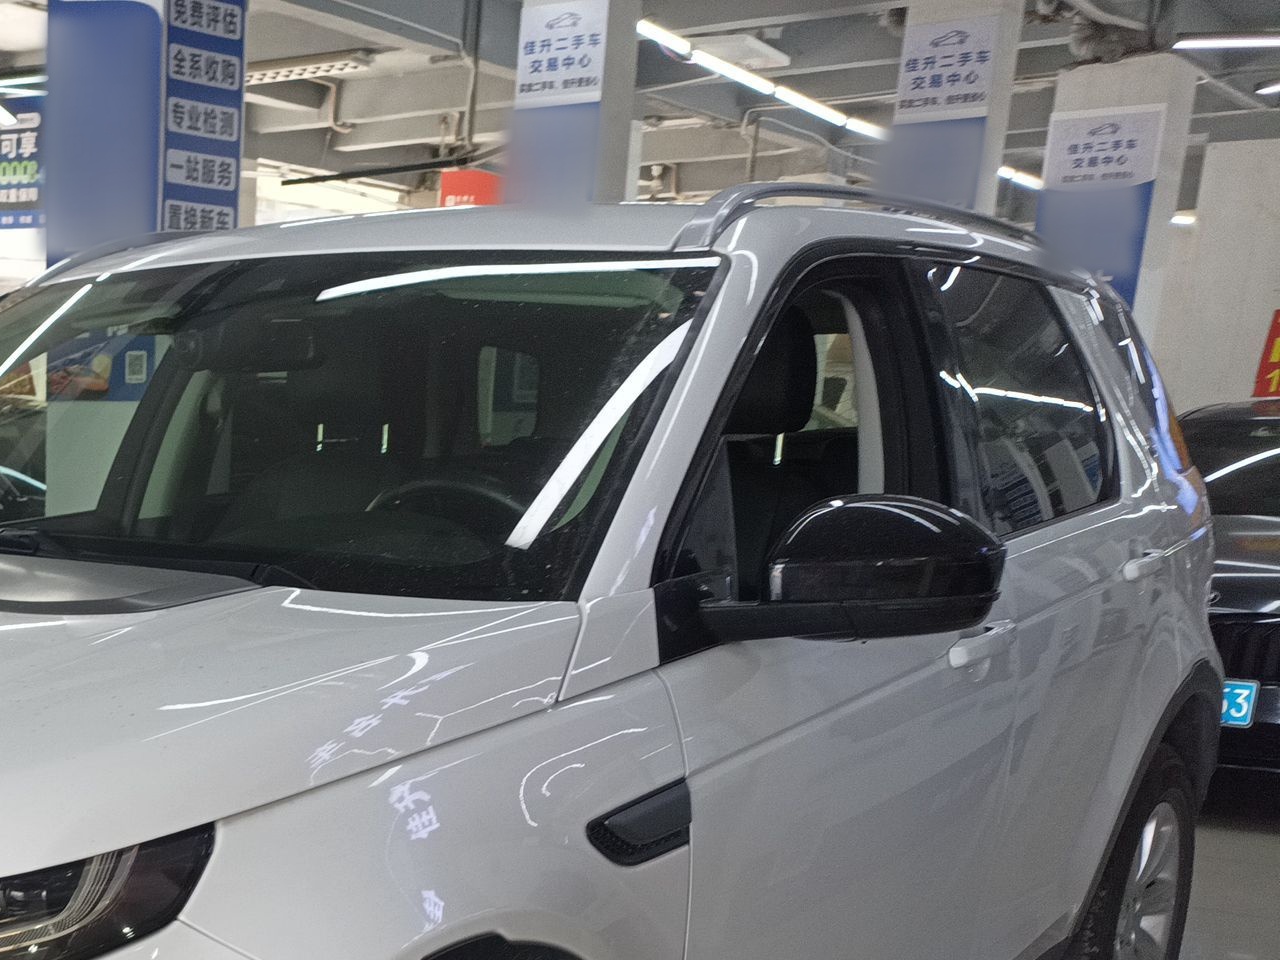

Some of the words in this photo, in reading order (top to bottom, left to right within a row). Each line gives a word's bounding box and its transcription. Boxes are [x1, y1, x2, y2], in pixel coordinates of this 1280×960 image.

[173, 0, 239, 36] 免费评估
[523, 33, 601, 55] 佳升二手车
[172, 49, 236, 86] 全系收购
[529, 53, 592, 74] 交易中心
[905, 50, 990, 72] 佳升二手车
[911, 70, 979, 91] 交易中心
[172, 102, 235, 137] 专业检测
[1067, 139, 1138, 155] 佳升二手车
[170, 155, 233, 187] 一站服务
[168, 205, 230, 230] 置换新车
